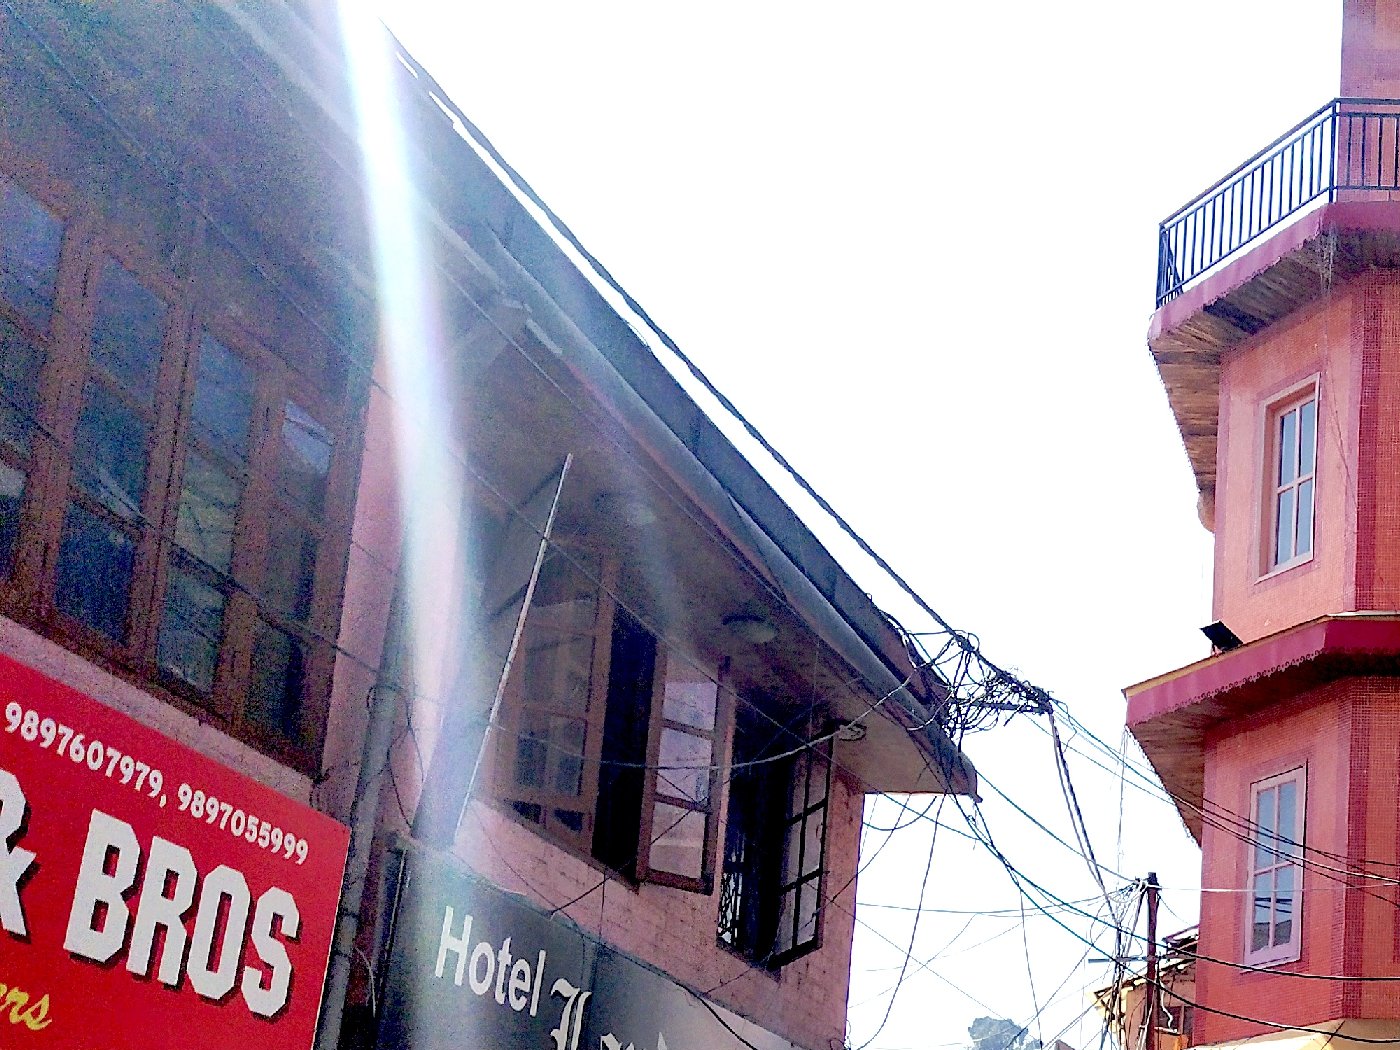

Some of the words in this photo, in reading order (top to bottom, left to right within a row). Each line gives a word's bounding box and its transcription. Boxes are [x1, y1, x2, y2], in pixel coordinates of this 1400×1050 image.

[5, 702, 167, 808] 9897607979,
[178, 783, 309, 865] 9897055999
[63, 808, 301, 1018] BROS
[434, 905, 547, 1018] Hotel
